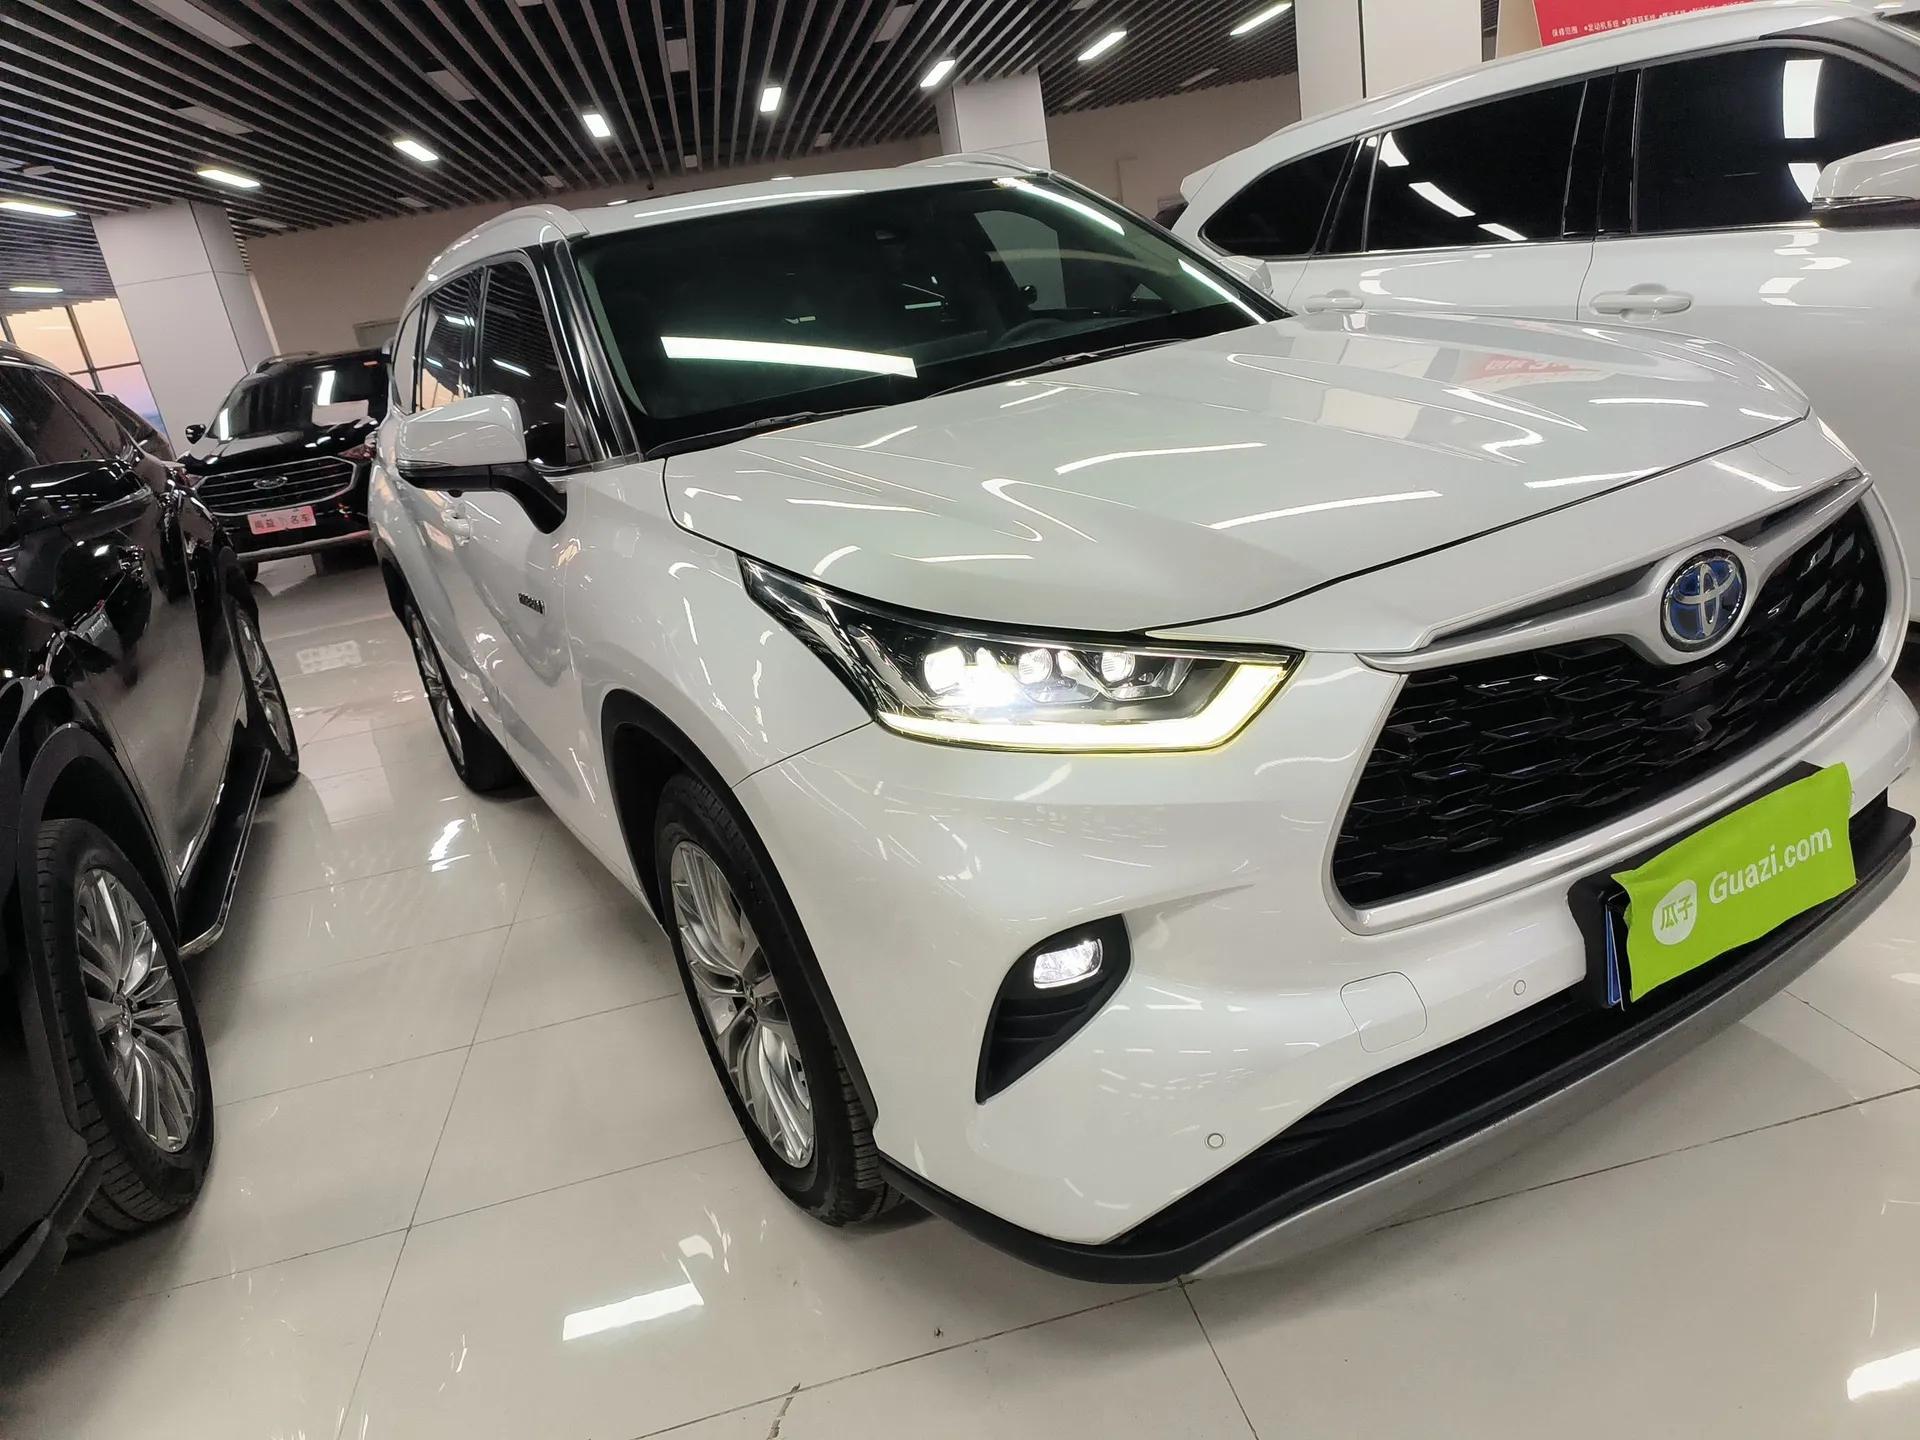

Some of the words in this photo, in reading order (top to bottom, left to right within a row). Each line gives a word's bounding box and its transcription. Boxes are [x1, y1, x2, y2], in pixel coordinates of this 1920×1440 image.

[1552, 26, 1578, 37] 保修范围
[1709, 828, 1832, 904] Guazi.com
[1660, 895, 1693, 930] 瓜子
